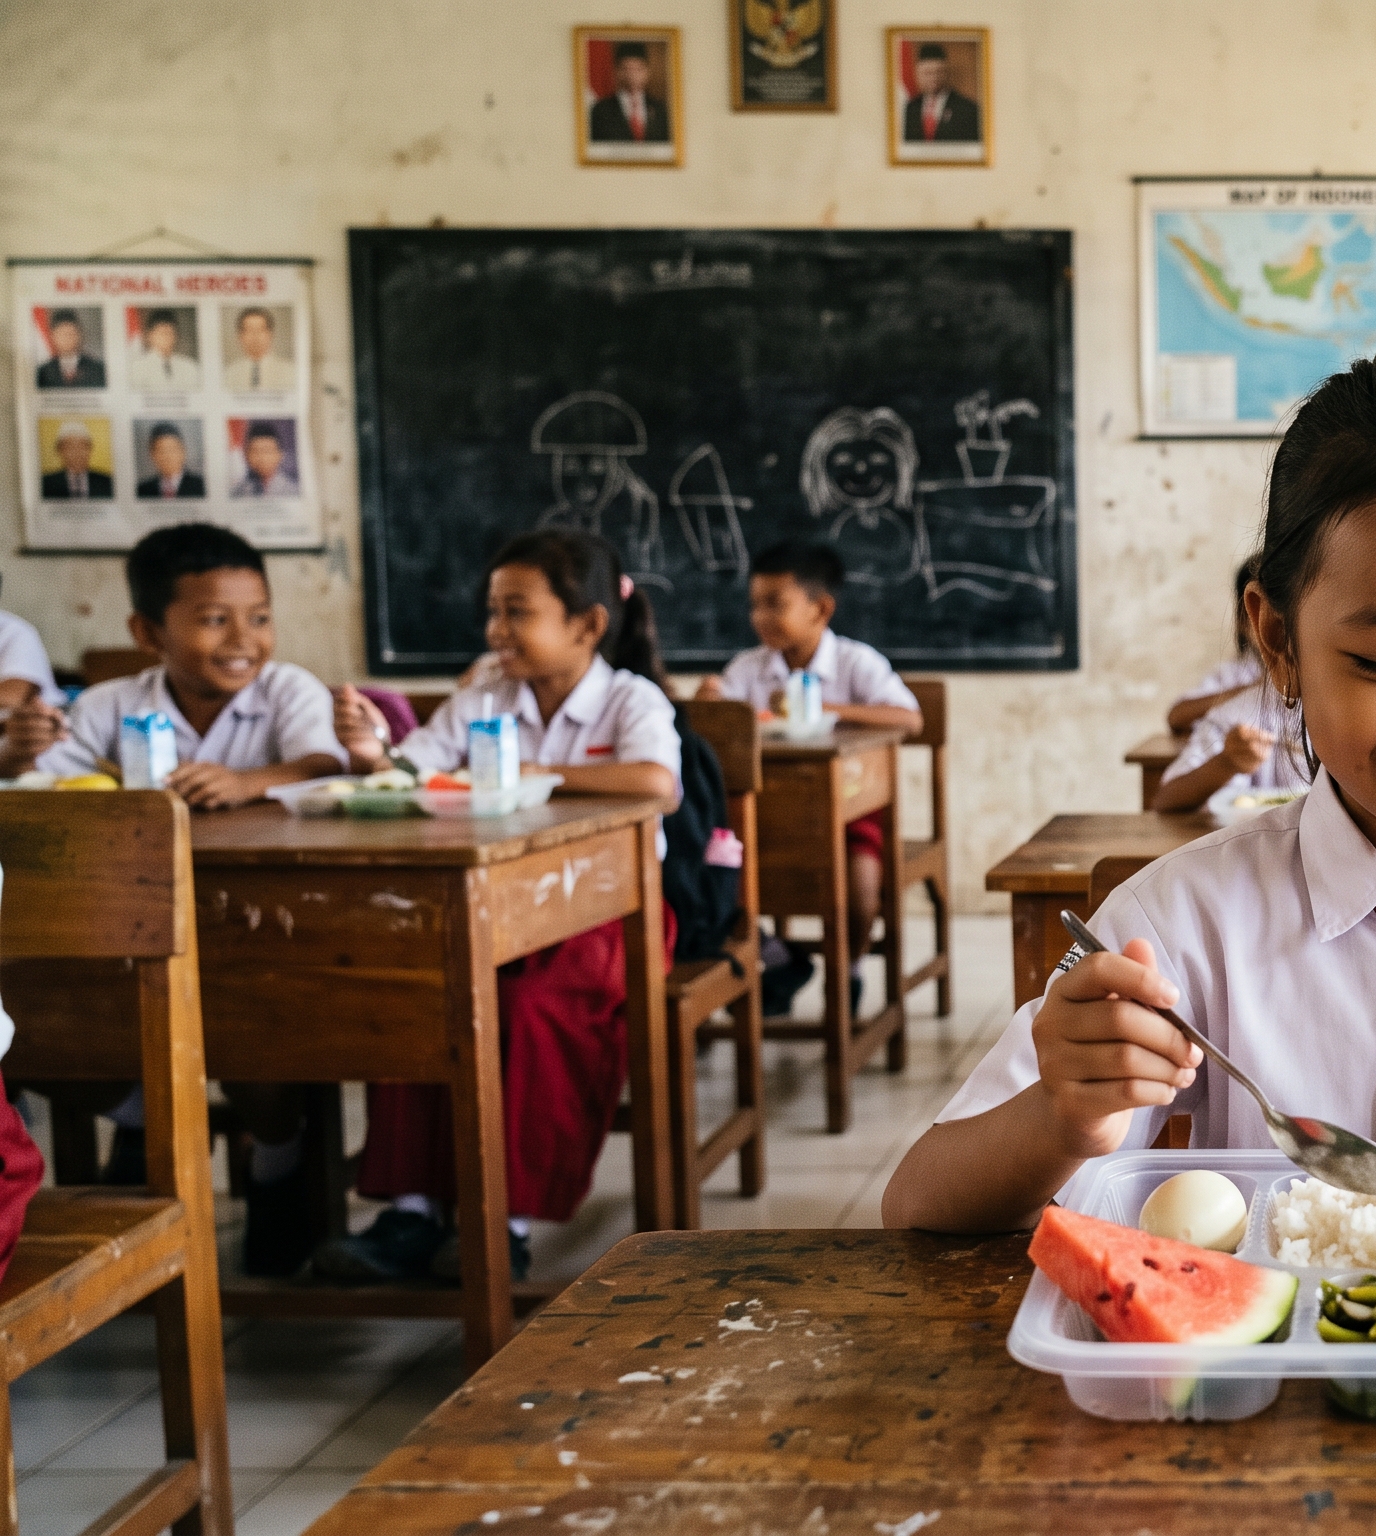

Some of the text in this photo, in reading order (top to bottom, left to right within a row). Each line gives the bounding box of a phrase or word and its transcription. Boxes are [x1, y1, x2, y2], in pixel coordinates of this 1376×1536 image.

[1230, 187, 1265, 204] MAP
[1275, 187, 1297, 204] OF
[55, 274, 267, 295] NATIONAL HEROES
